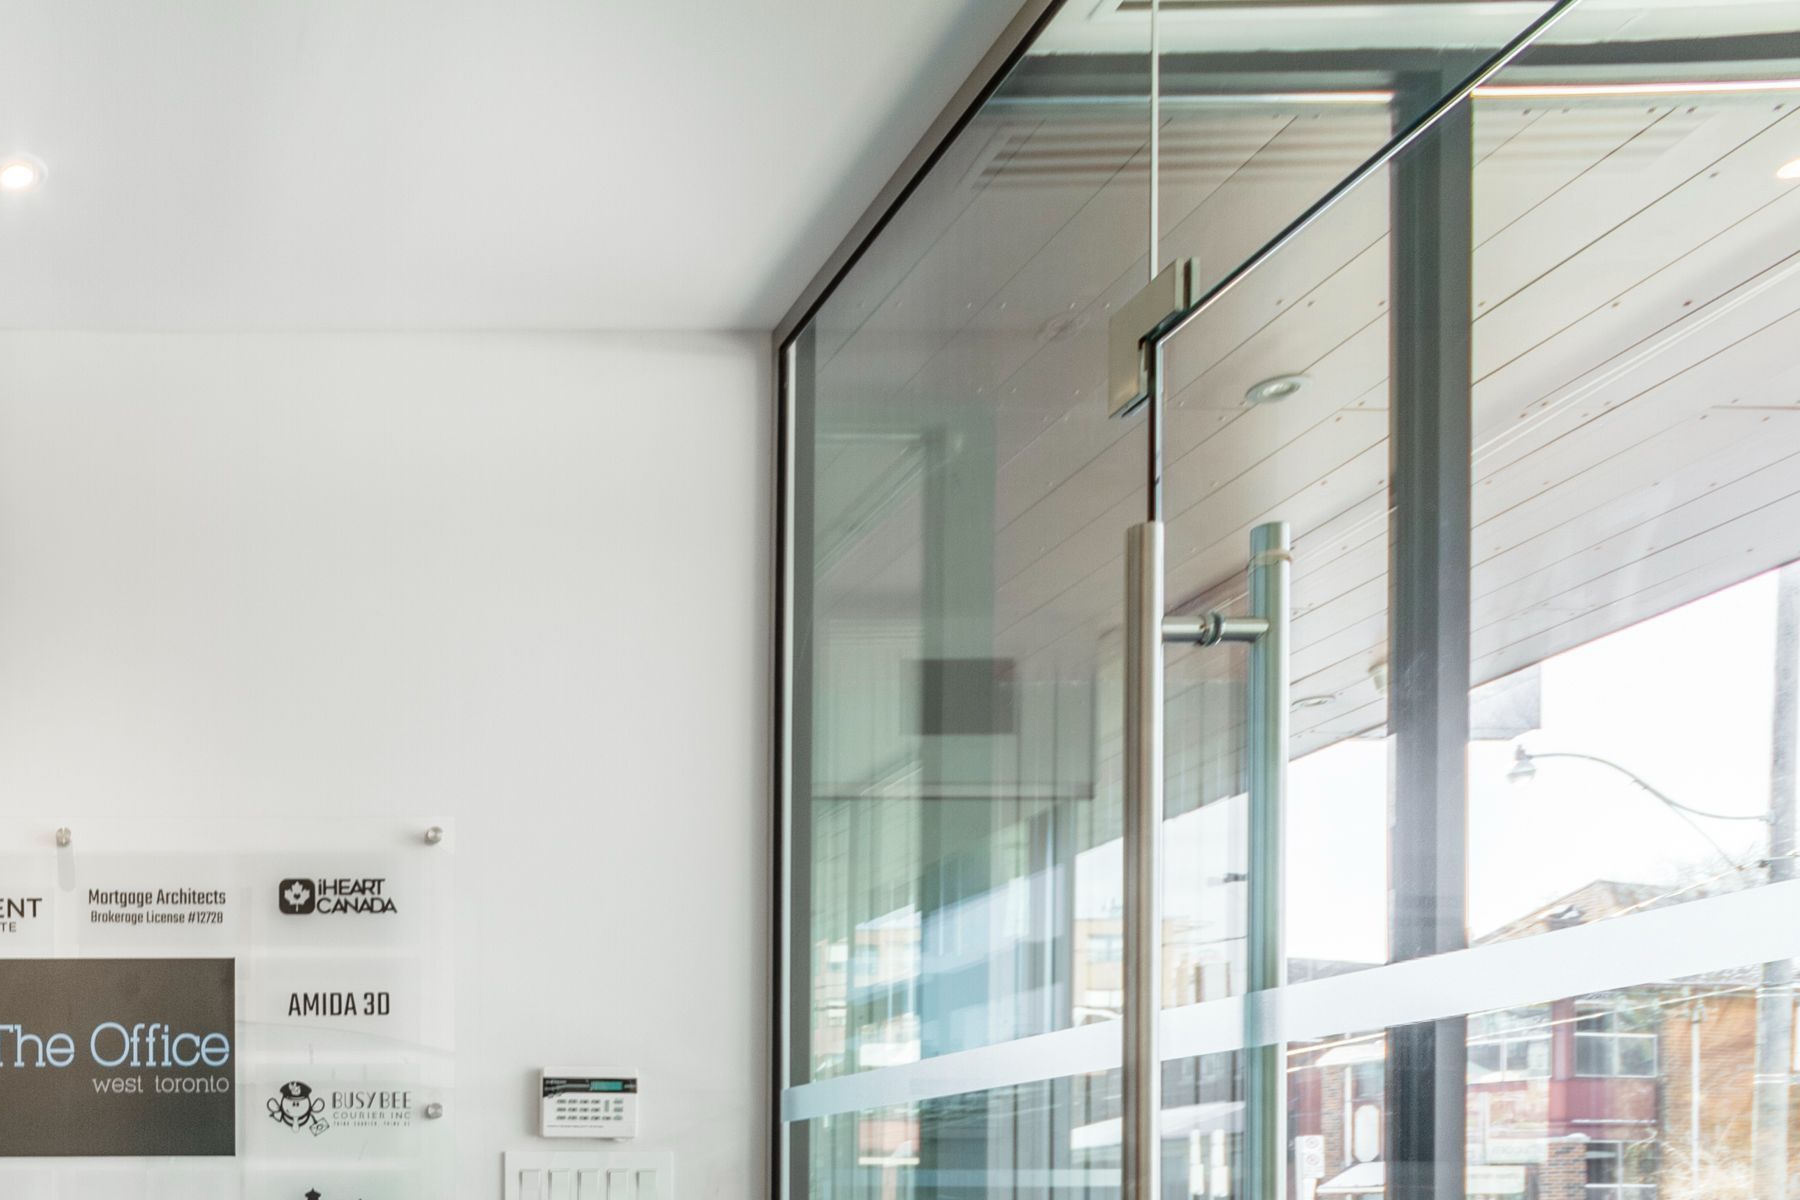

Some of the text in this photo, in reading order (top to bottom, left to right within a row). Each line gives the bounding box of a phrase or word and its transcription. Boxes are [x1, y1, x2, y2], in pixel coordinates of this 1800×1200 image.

[318, 878, 385, 896] iHEART
[88, 888, 226, 908] Mortgage Architects
[317, 898, 398, 914] CANADA
[91, 911, 144, 925] Brokerage
[146, 911, 185, 924] License
[288, 993, 390, 1017] AMIDA 3D
[90, 1022, 230, 1068] Office
[92, 1077, 230, 1094] west toronto
[391, 1112, 411, 1120] INC
